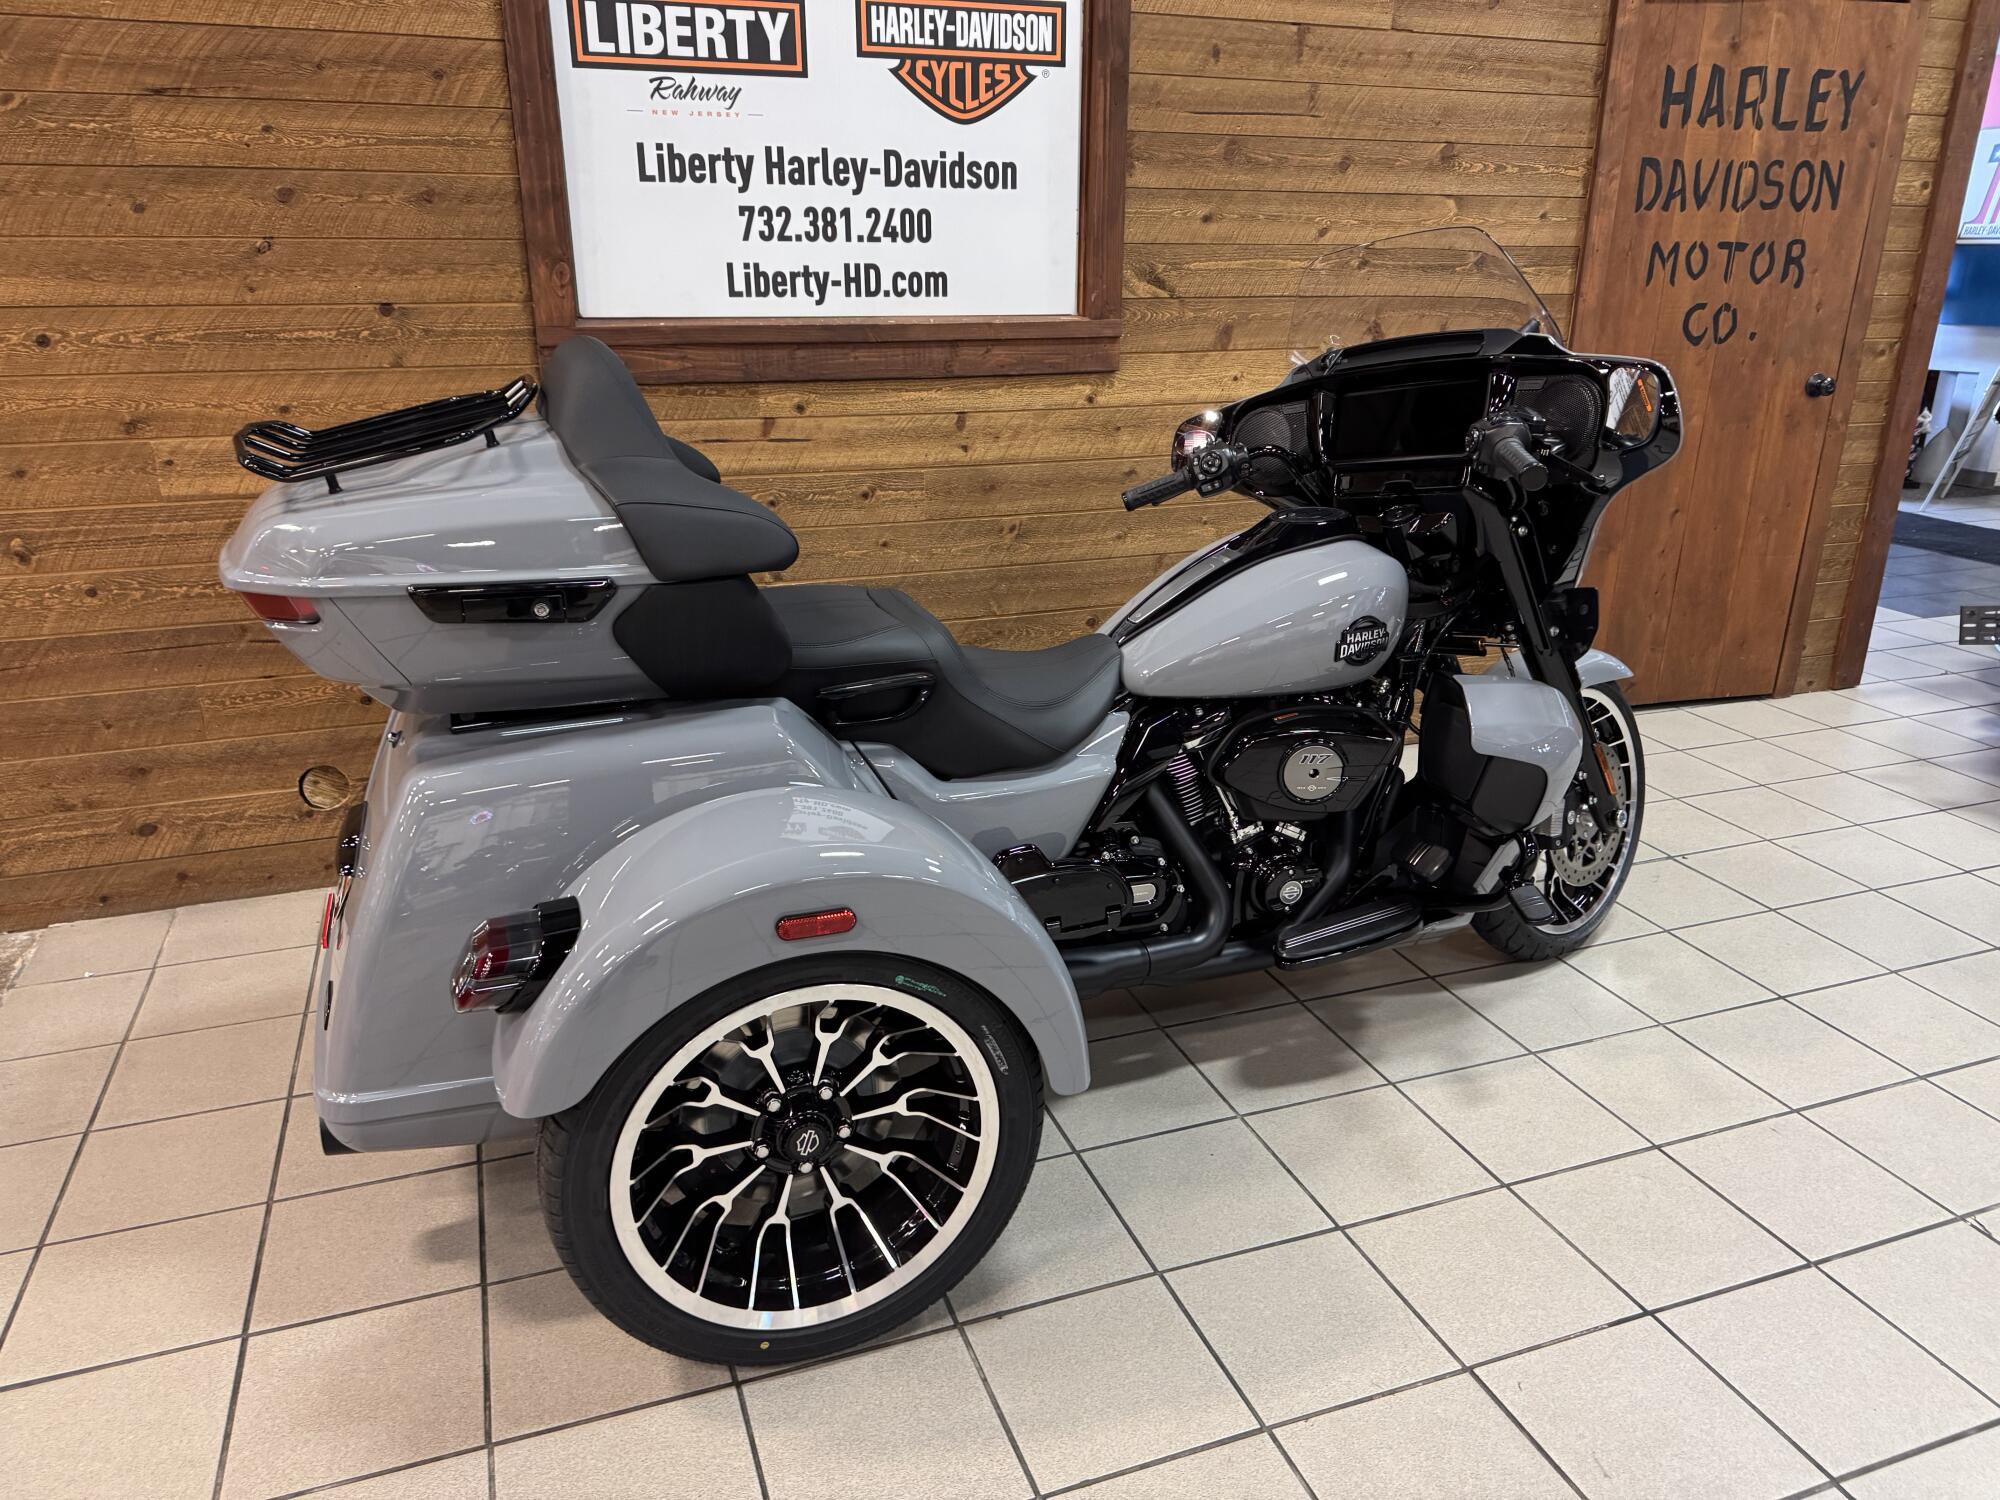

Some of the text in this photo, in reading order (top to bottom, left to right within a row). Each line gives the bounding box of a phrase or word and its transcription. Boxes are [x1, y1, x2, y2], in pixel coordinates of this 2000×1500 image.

[584, 0, 790, 61] LIBERTY
[870, 5, 1053, 52] HARLEY-DAVIDSON
[648, 76, 742, 110] Rahway
[915, 59, 1011, 110] CYCLES
[1659, 63, 1866, 132] HARLEY
[636, 142, 1018, 196] Liberty Harley-Davidson
[1634, 157, 1845, 213] DAVIDSON
[738, 205, 932, 243] 732.381.2400
[726, 262, 948, 306] Liberty-HD.com
[1645, 238, 1807, 289] MOTOR
[1682, 302, 1758, 347] CO.
[1299, 753, 1334, 765] 117
